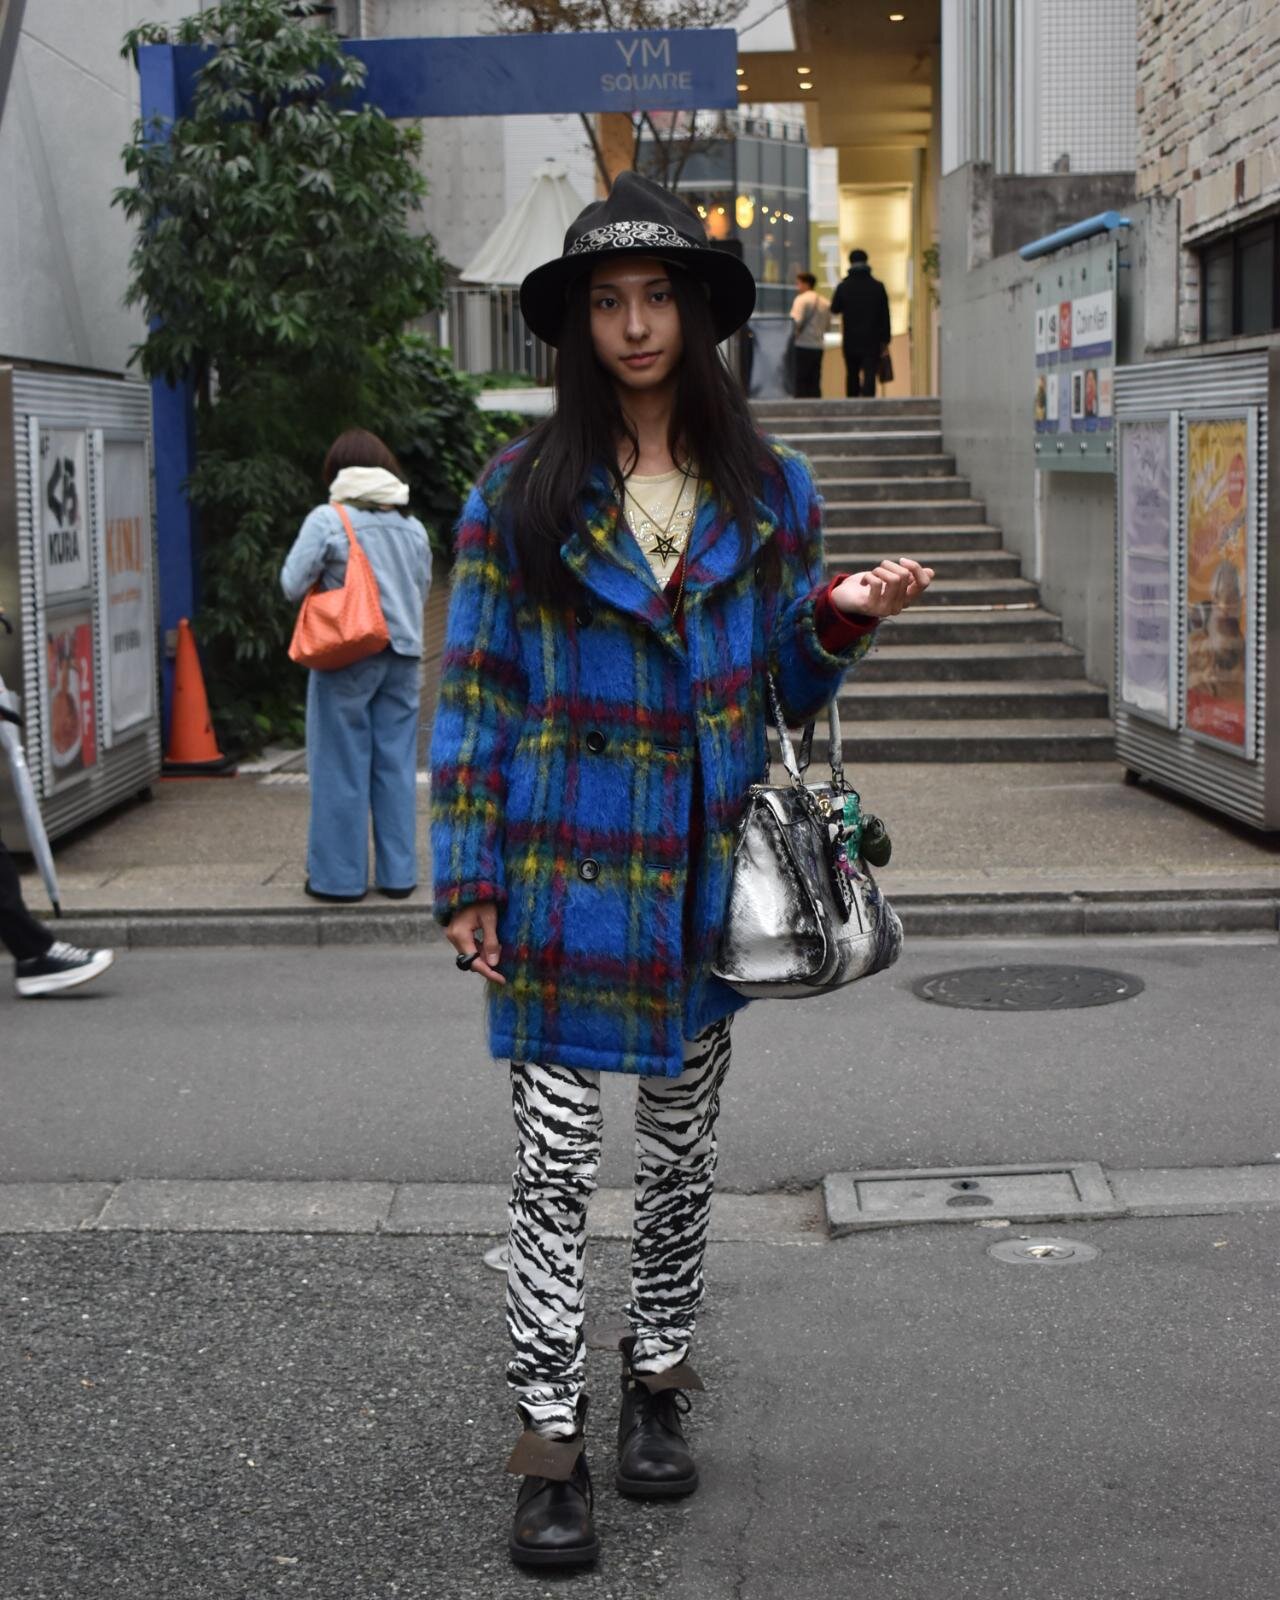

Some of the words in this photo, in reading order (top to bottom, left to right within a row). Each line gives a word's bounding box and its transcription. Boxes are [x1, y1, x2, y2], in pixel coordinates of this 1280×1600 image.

[615, 38, 671, 67] YM
[600, 71, 693, 92] SQUARE
[48, 530, 81, 566] KURA
